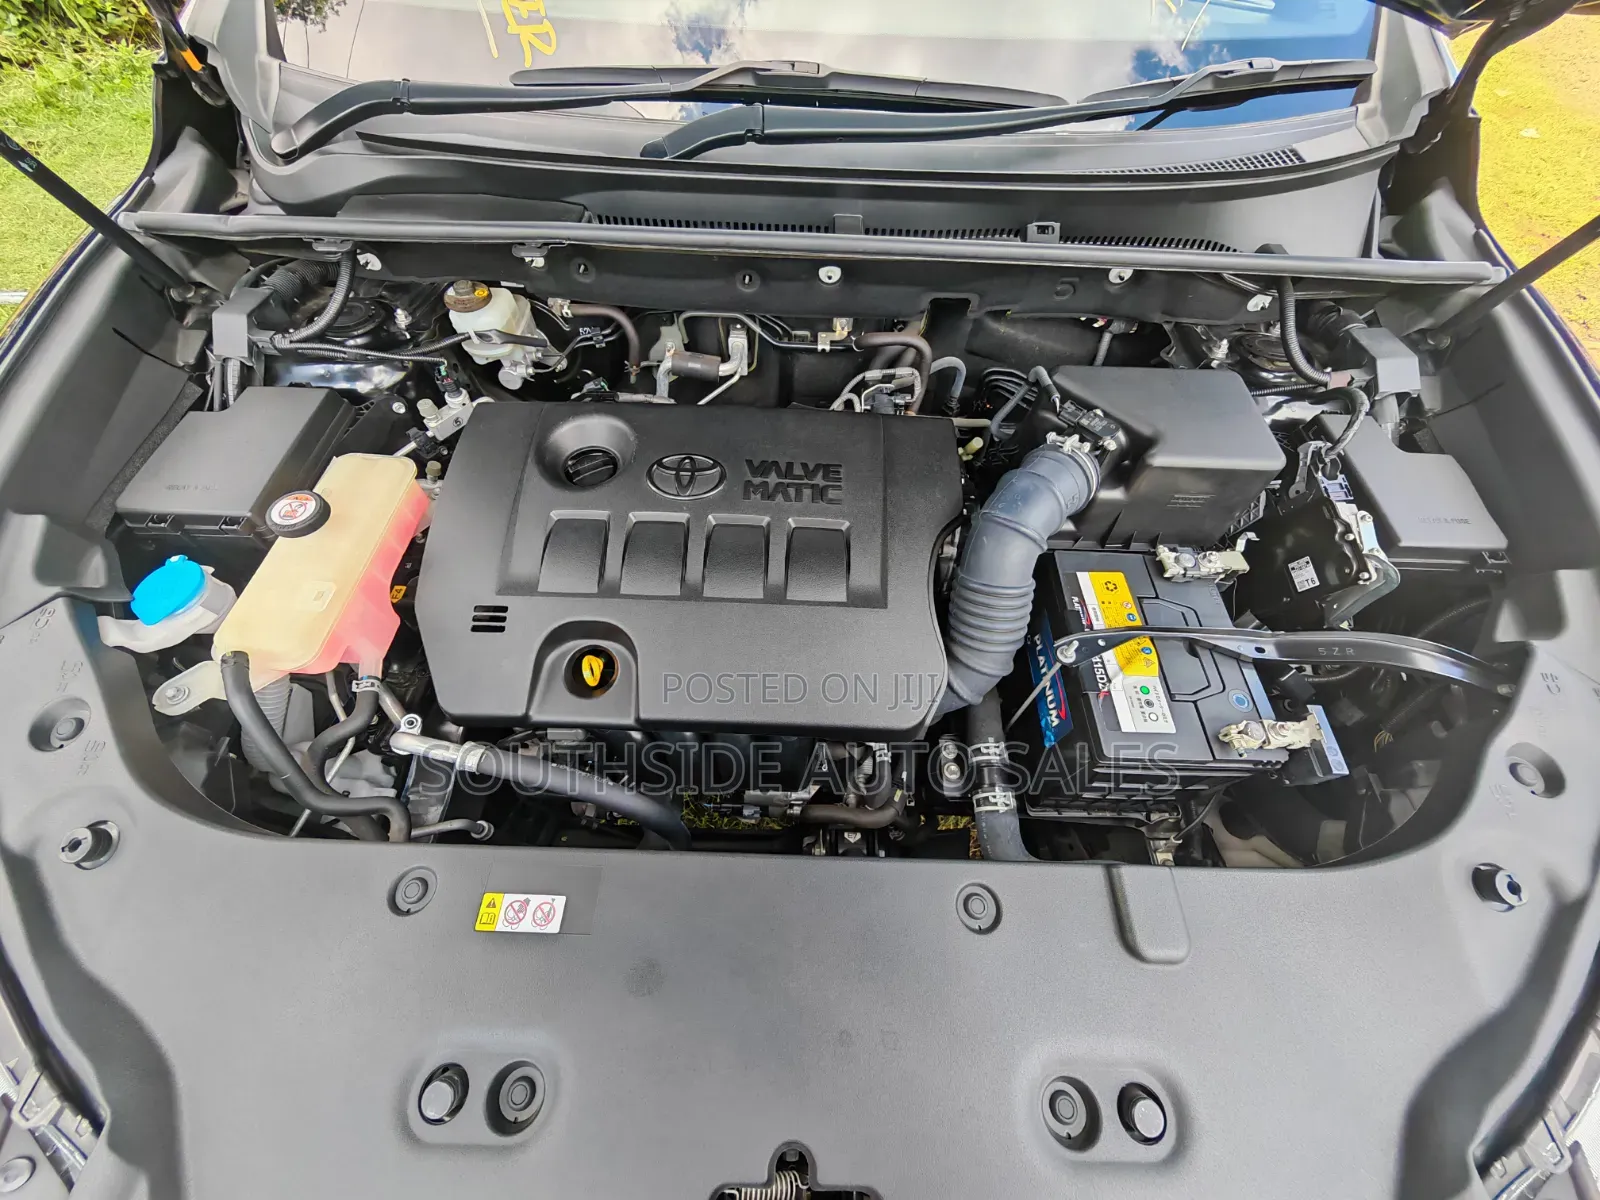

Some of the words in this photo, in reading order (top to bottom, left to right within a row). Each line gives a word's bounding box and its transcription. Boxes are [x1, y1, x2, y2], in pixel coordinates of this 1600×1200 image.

[744, 459, 843, 483] VALVE
[742, 480, 843, 505] MATIC
[1305, 577, 1317, 588] T6
[1033, 633, 1061, 728] PLATNUM
